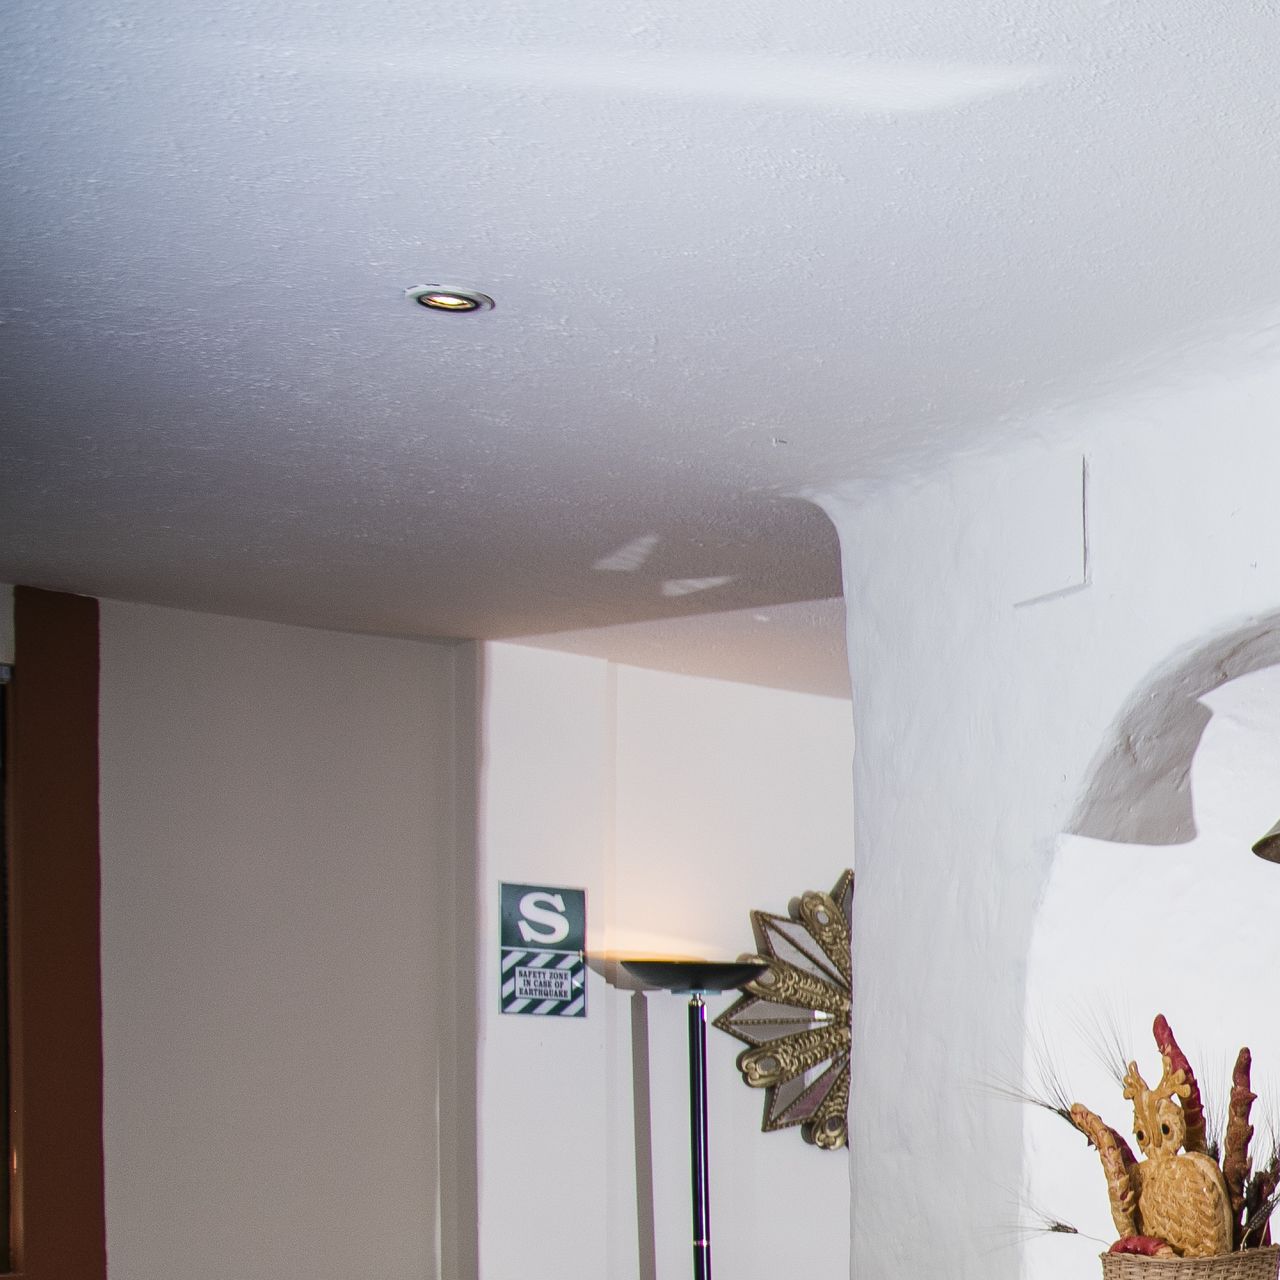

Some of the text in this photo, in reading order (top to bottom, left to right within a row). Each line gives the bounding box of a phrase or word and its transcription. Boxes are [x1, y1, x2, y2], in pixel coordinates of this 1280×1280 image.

[517, 891, 570, 944] S
[519, 970, 568, 980] SAFETY ZONE
[523, 979, 564, 989] IN CASE OF
[519, 988, 568, 998] EARTHQUAKE
